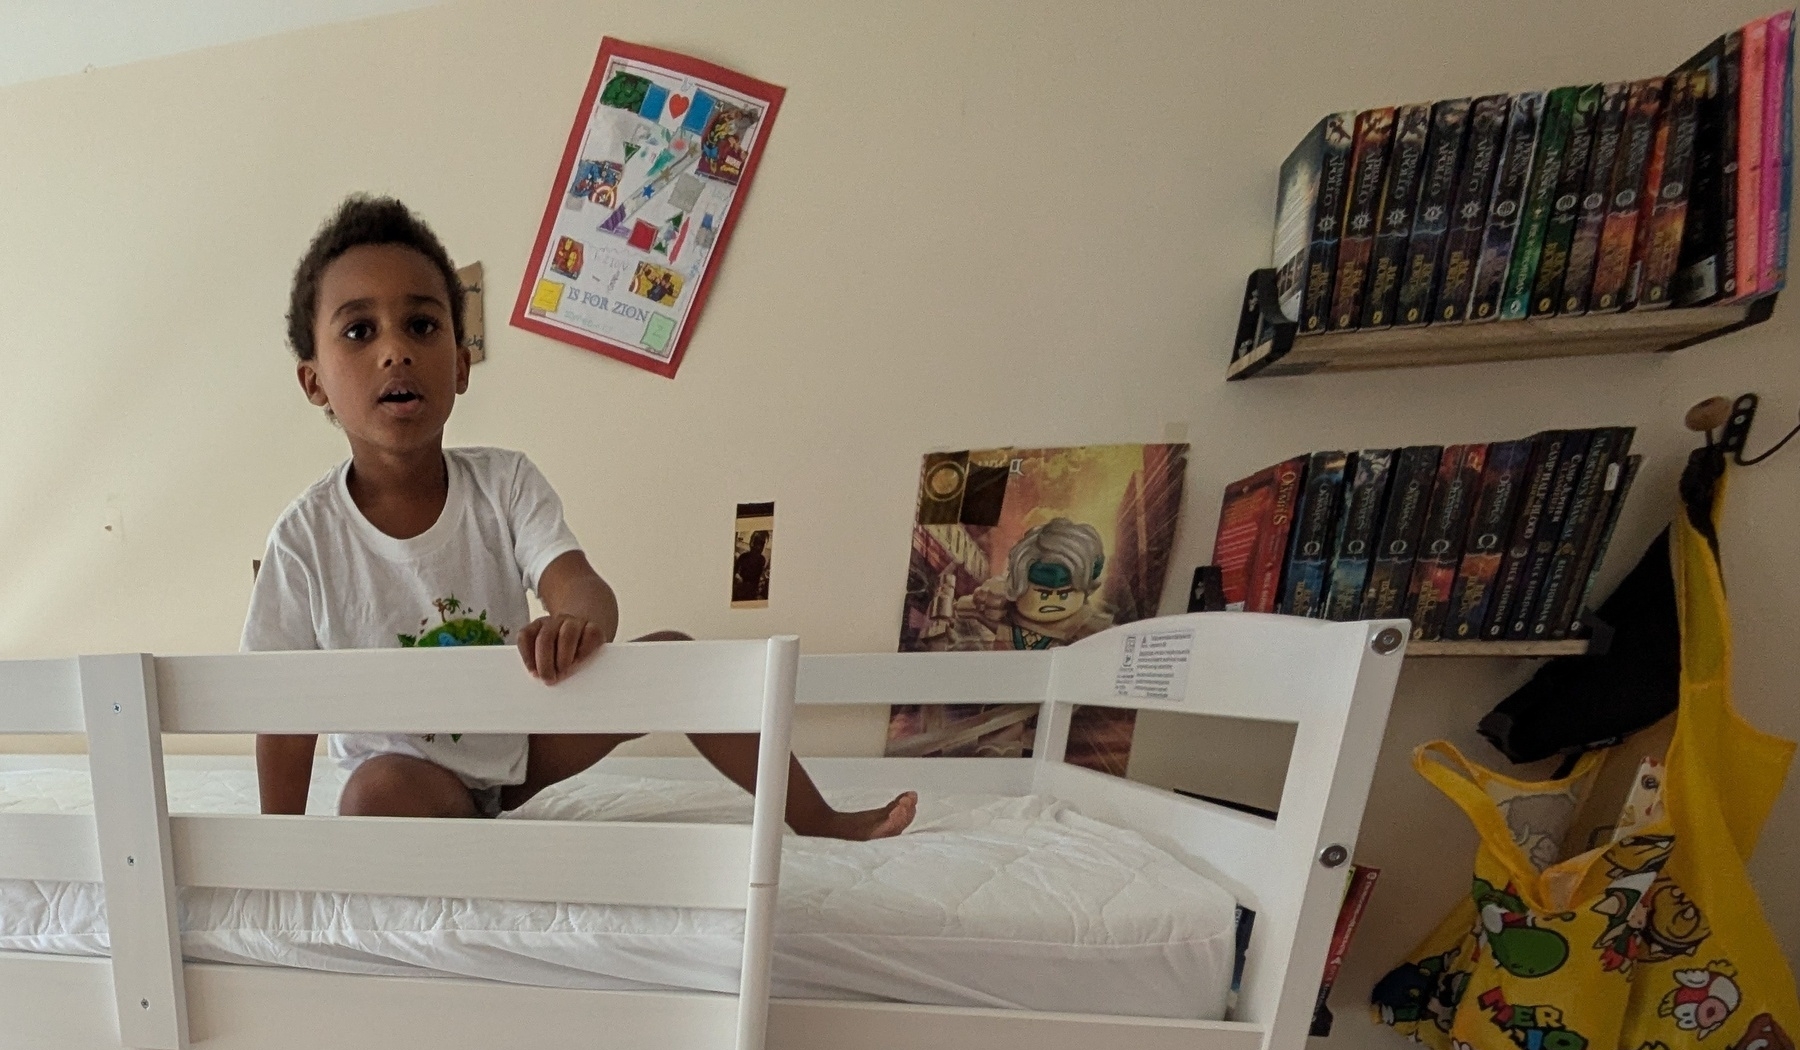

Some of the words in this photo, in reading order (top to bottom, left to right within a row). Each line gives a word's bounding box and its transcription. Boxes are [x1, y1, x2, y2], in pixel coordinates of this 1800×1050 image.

[1322, 153, 1338, 207] APOLLO
[567, 286, 581, 301] IS
[581, 290, 609, 312] FOR
[611, 300, 650, 325] ZION
[1546, 441, 1561, 470] CAMP
[1565, 453, 1583, 482] CAMP
[1506, 560, 1519, 583] RICK
[1531, 555, 1543, 578] RICK
[1553, 557, 1567, 580] RICK
[1493, 583, 1512, 624] RIORDAN
[1518, 579, 1536, 620] RIORDAN
[1538, 580, 1558, 623] RIORDAN
